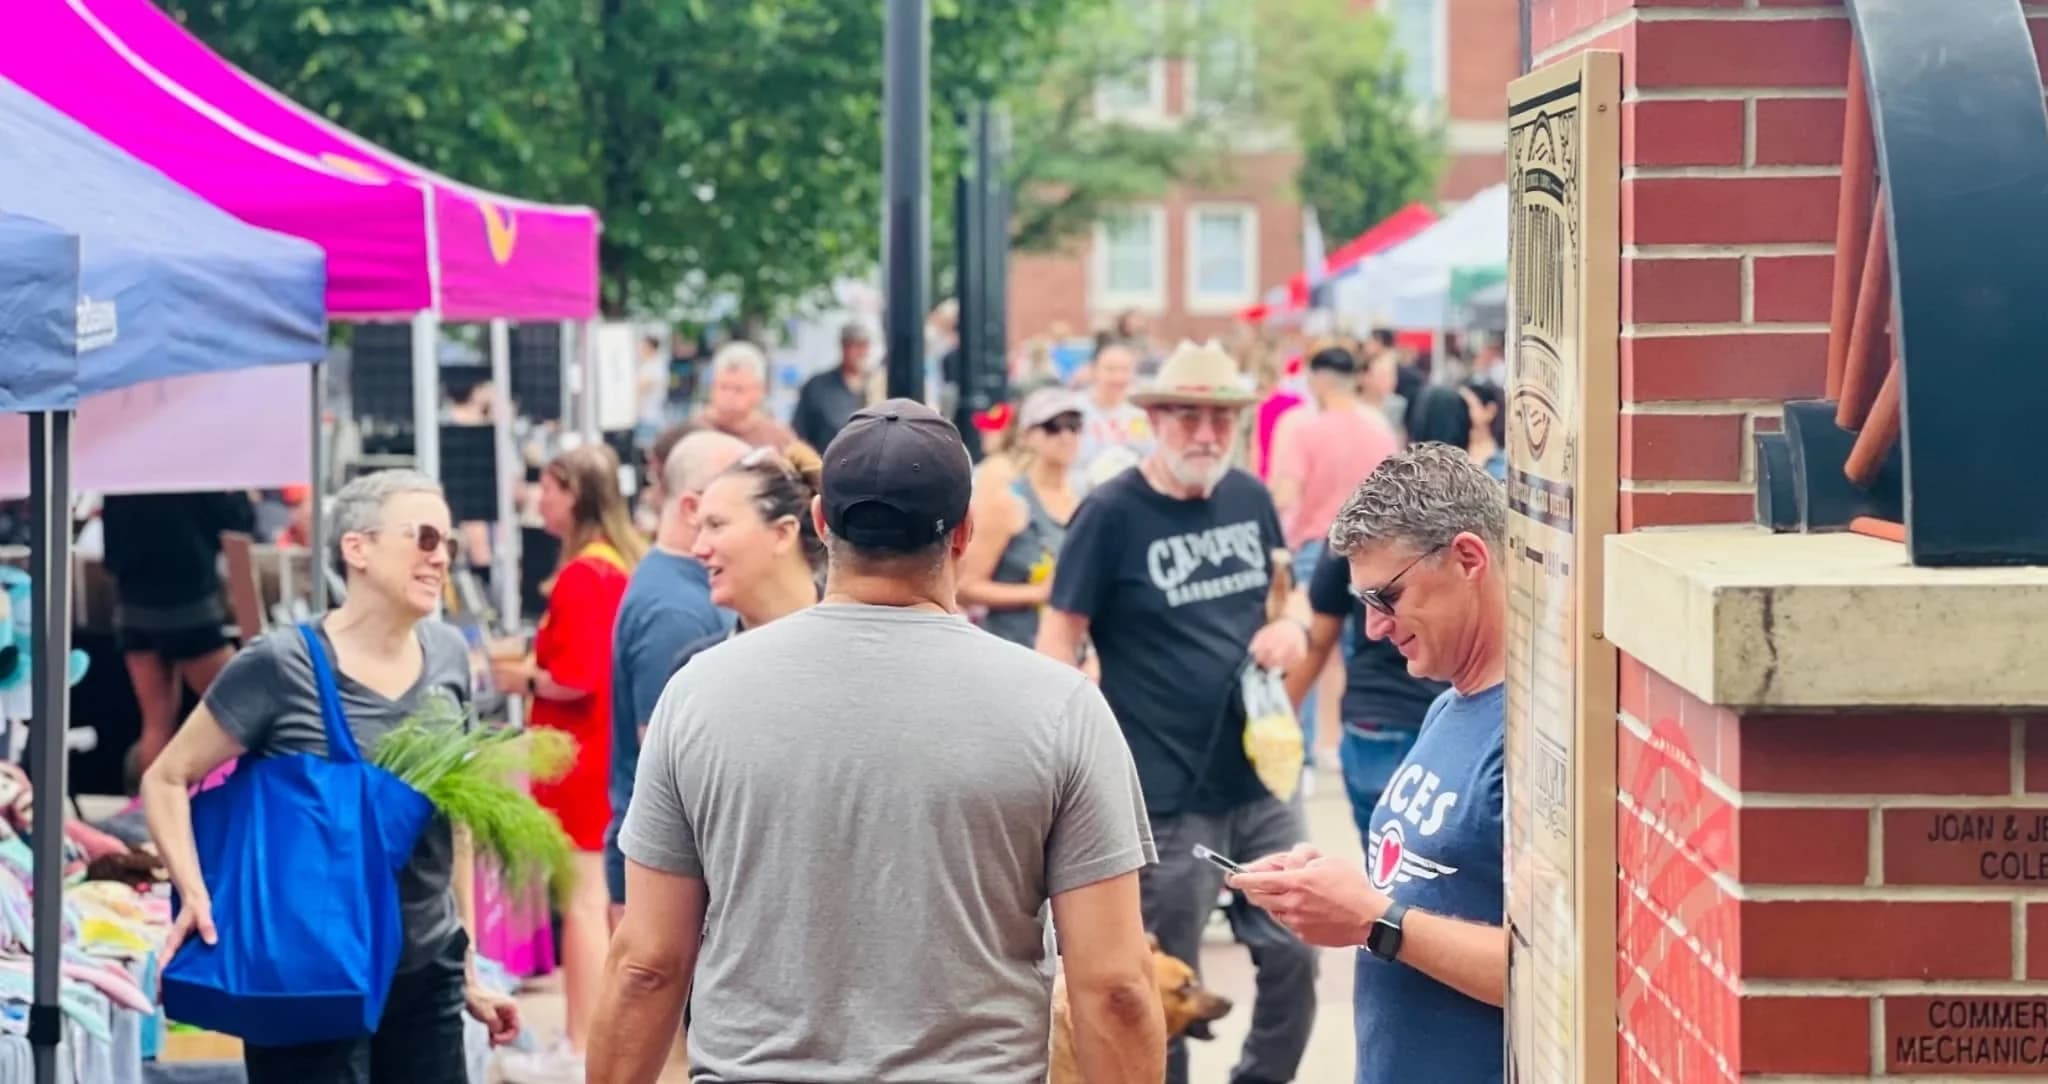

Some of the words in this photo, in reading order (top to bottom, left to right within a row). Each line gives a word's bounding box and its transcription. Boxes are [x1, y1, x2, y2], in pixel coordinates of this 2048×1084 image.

[1146, 520, 1265, 592] CAMPUS
[1928, 814, 1994, 843] JOAN
[2002, 813, 2019, 842] &
[1928, 1000, 2048, 1030] COMMER
